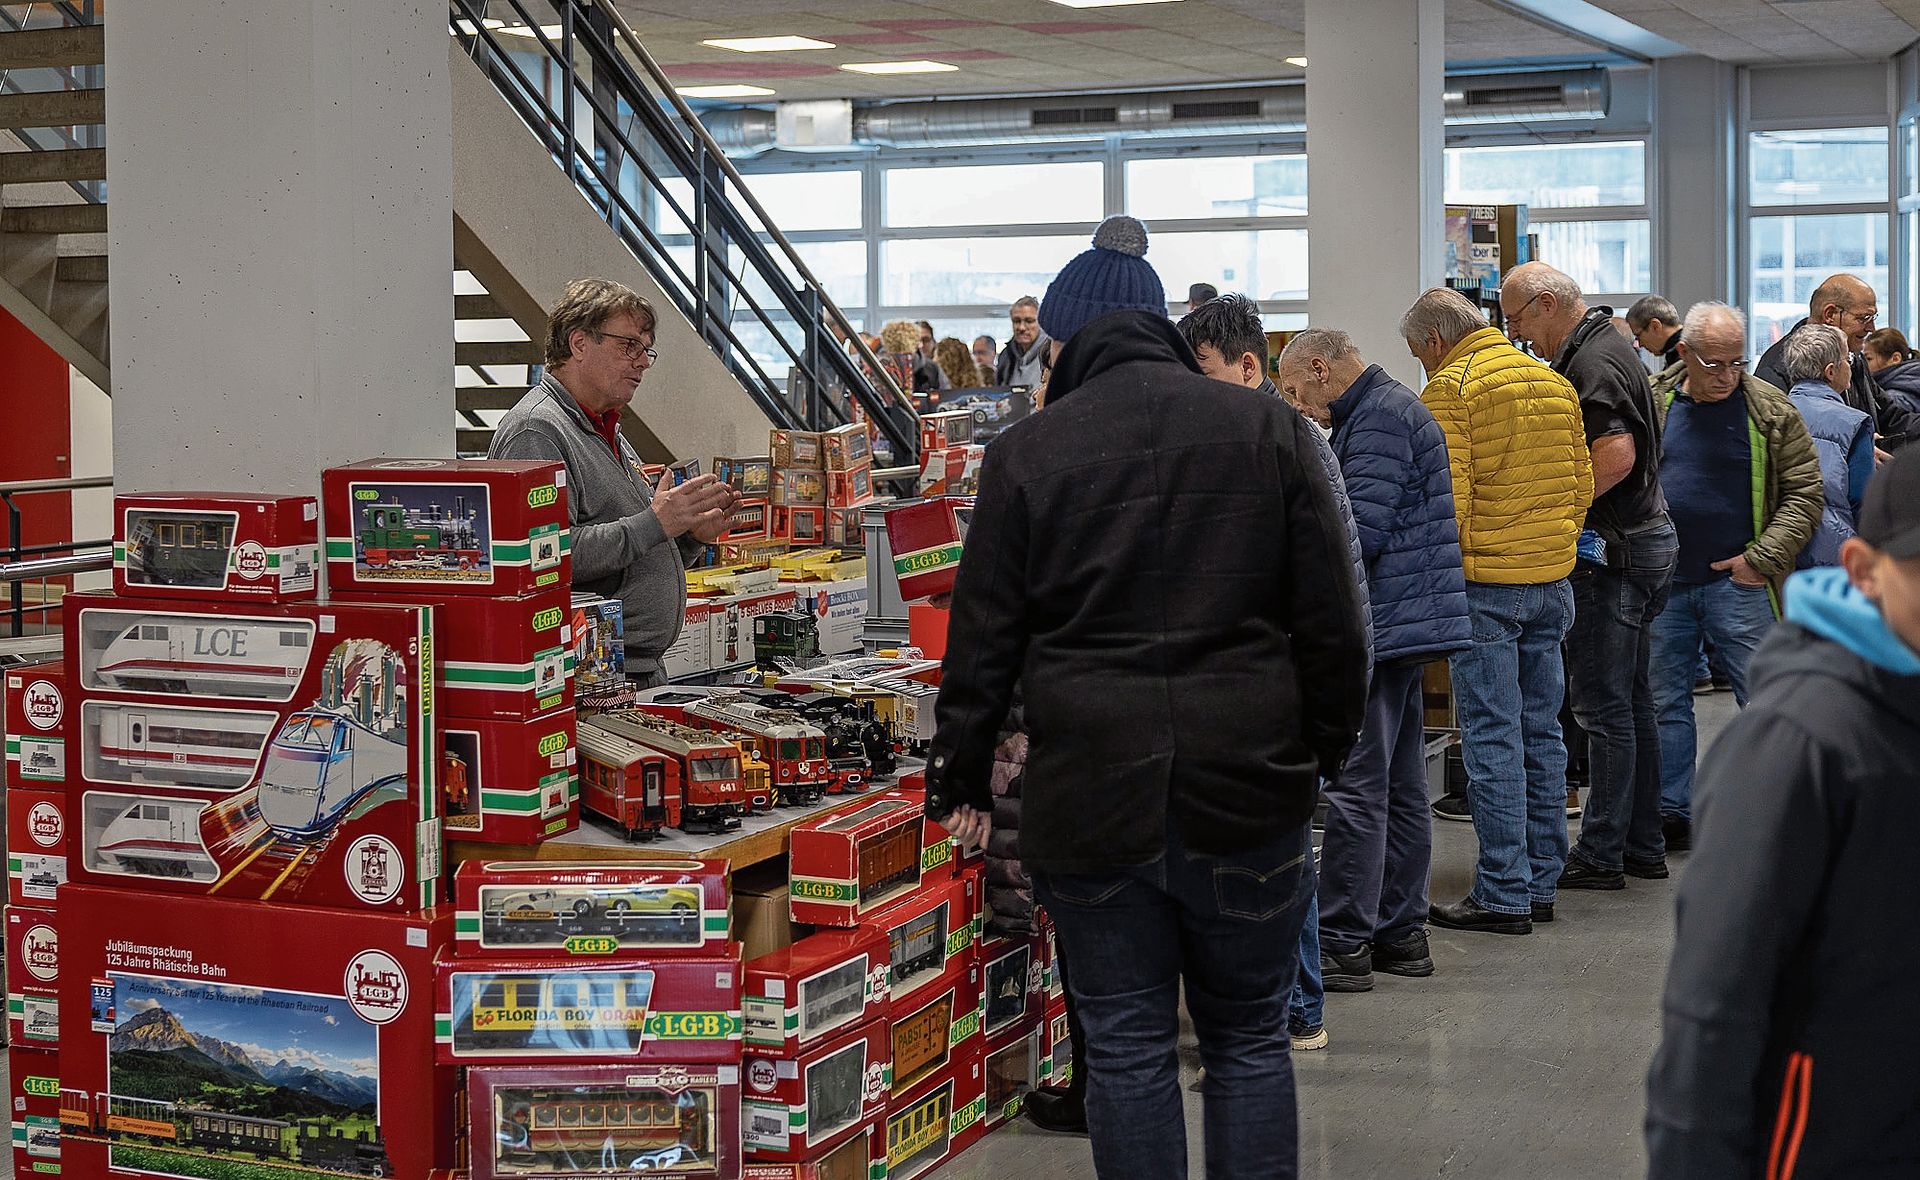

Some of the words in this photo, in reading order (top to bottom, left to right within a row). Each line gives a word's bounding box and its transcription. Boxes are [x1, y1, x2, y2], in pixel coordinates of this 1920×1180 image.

[910, 552, 941, 570] LGB
[537, 610, 559, 628] LGB
[684, 610, 709, 626] PROMO
[746, 602, 774, 617] SHELVES
[193, 627, 249, 657] LCE
[543, 734, 564, 754] LGB
[720, 783, 736, 792] 641
[926, 842, 947, 867] LGB
[802, 882, 836, 898] LGB
[574, 940, 610, 951] LGB
[950, 927, 970, 953] LGB
[105, 939, 193, 961] Jubiläumspackung
[106, 953, 122, 966] 125
[123, 955, 151, 969] Jahre
[152, 958, 200, 974] Rhätische
[201, 962, 227, 977] Bahn
[93, 987, 112, 997] 125
[129, 982, 174, 998] Anniversary
[189, 989, 202, 998] for
[203, 991, 215, 1000] 125
[215, 992, 238, 1002] Years
[238, 994, 248, 1004] of
[249, 996, 260, 1005] the
[261, 997, 295, 1009] Rhaetian
[296, 1001, 329, 1014] Railroad
[366, 987, 389, 999] LGB
[497, 1008, 560, 1022] FLORIDA
[565, 1008, 595, 1022] BOY
[603, 1008, 646, 1022] ORAN
[663, 1015, 720, 1036] LGB
[898, 1025, 921, 1045] PABST
[955, 1014, 975, 1041] LGB
[30, 1079, 60, 1094] LGB
[955, 1104, 975, 1131] LGB
